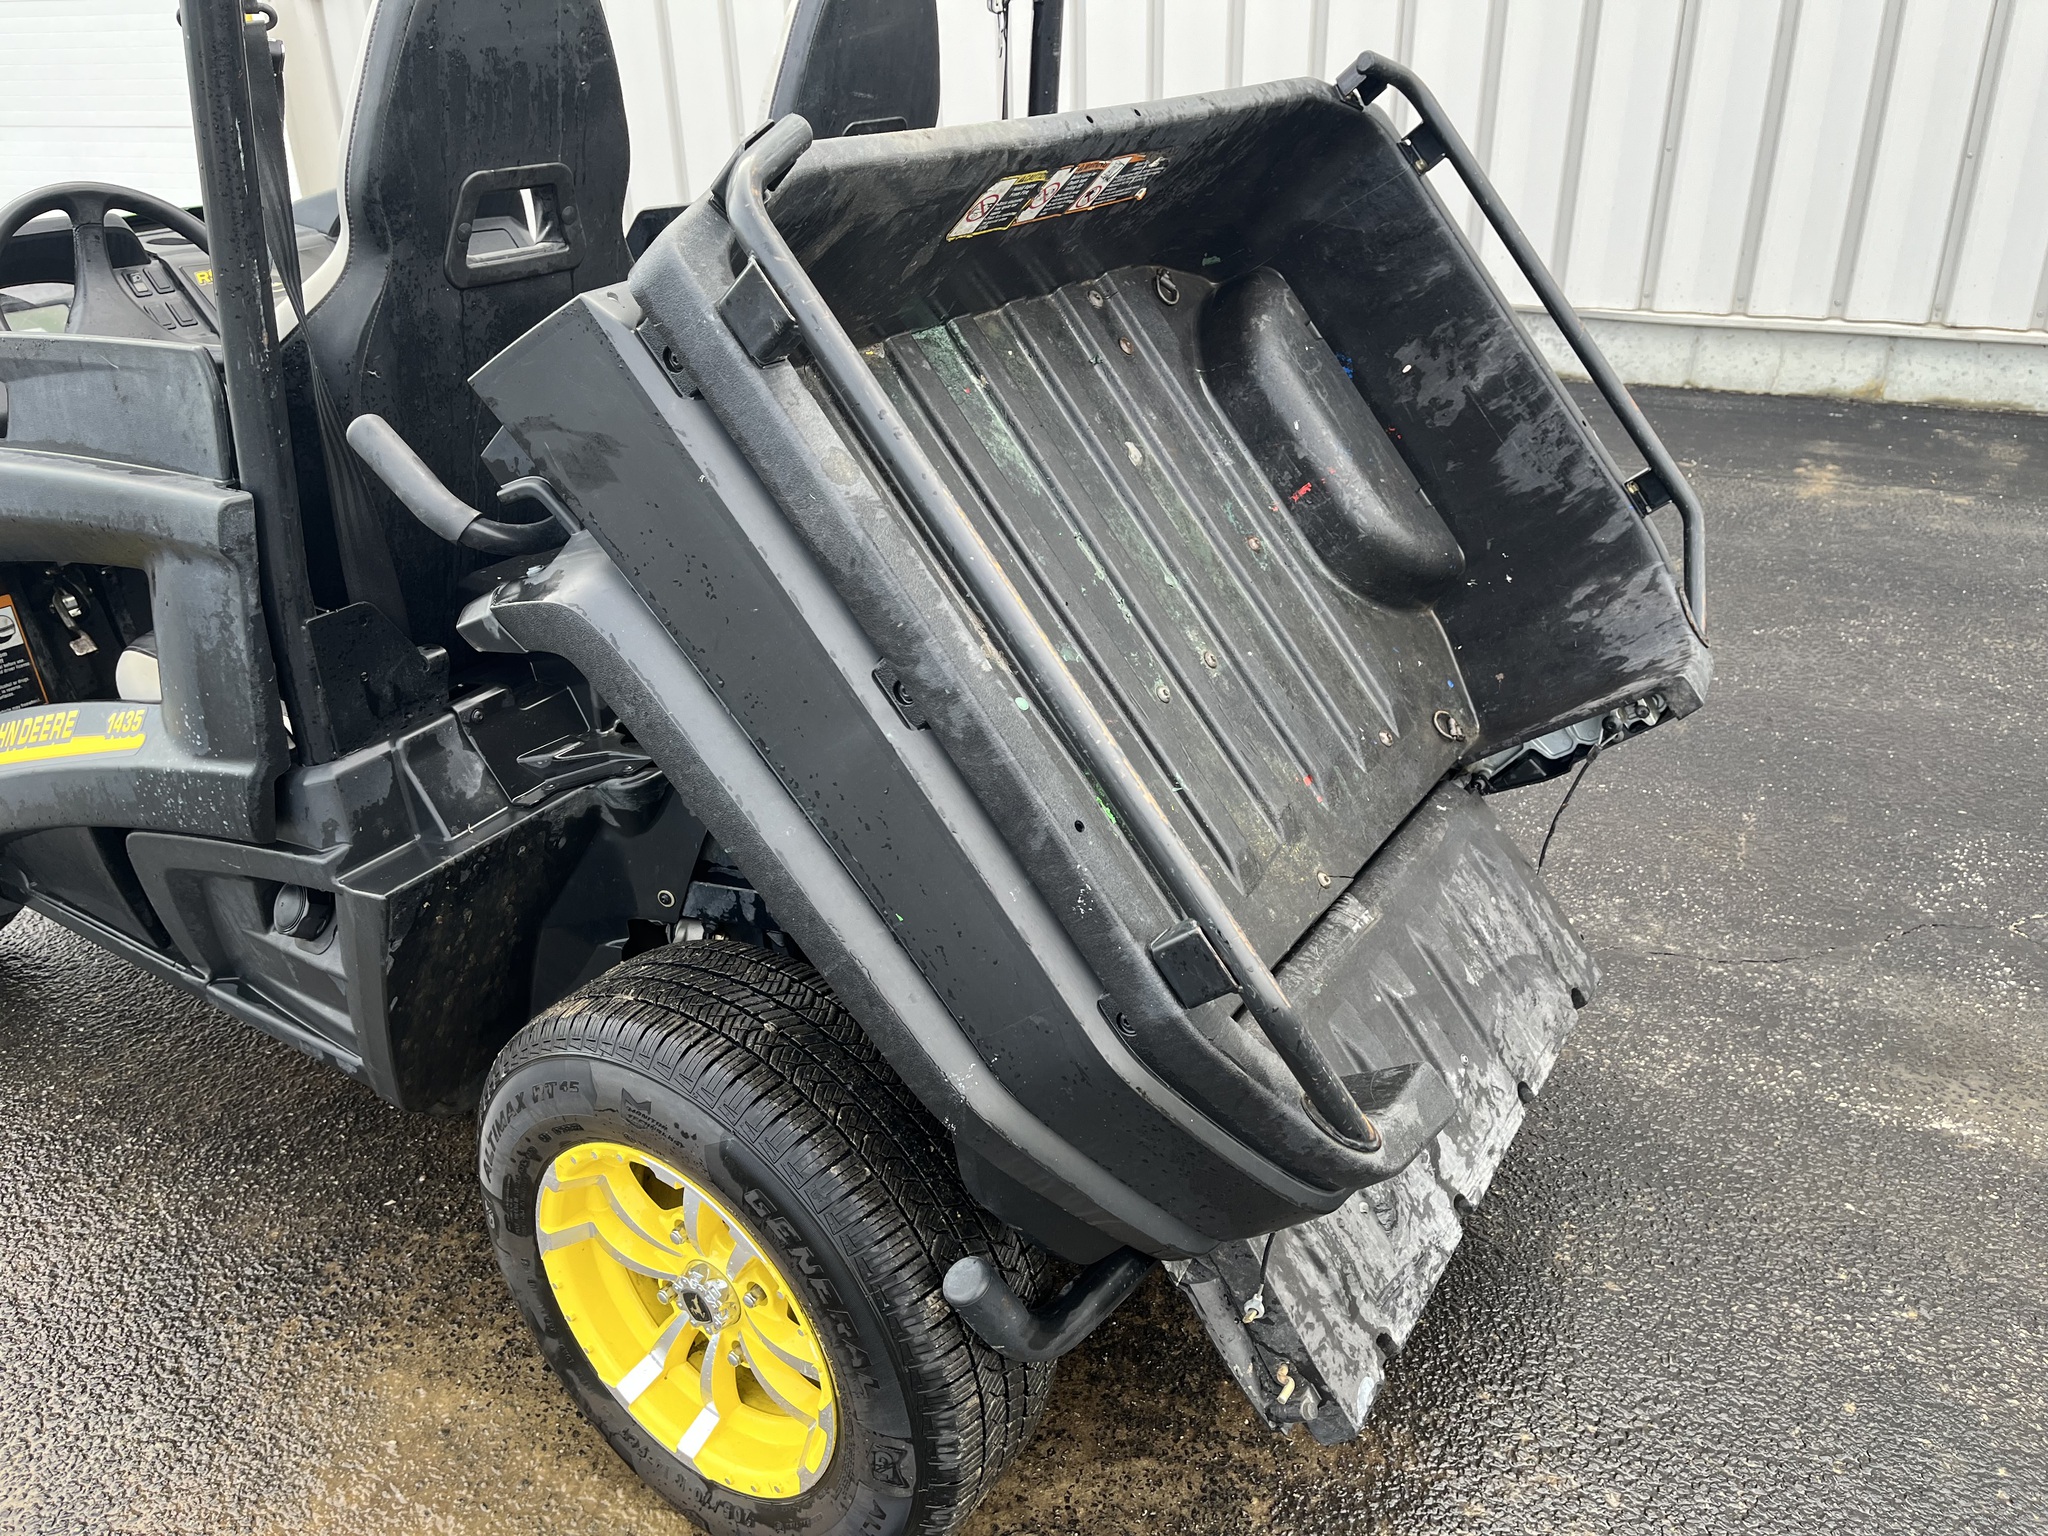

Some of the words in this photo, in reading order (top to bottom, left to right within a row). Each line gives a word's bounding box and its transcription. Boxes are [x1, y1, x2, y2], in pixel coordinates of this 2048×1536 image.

[0, 719, 21, 749] HN
[18, 709, 79, 745] DEERE
[107, 709, 146, 734] 1435
[483, 1091, 527, 1184] ALTIMAX
[743, 1188, 882, 1396] GENERAL
